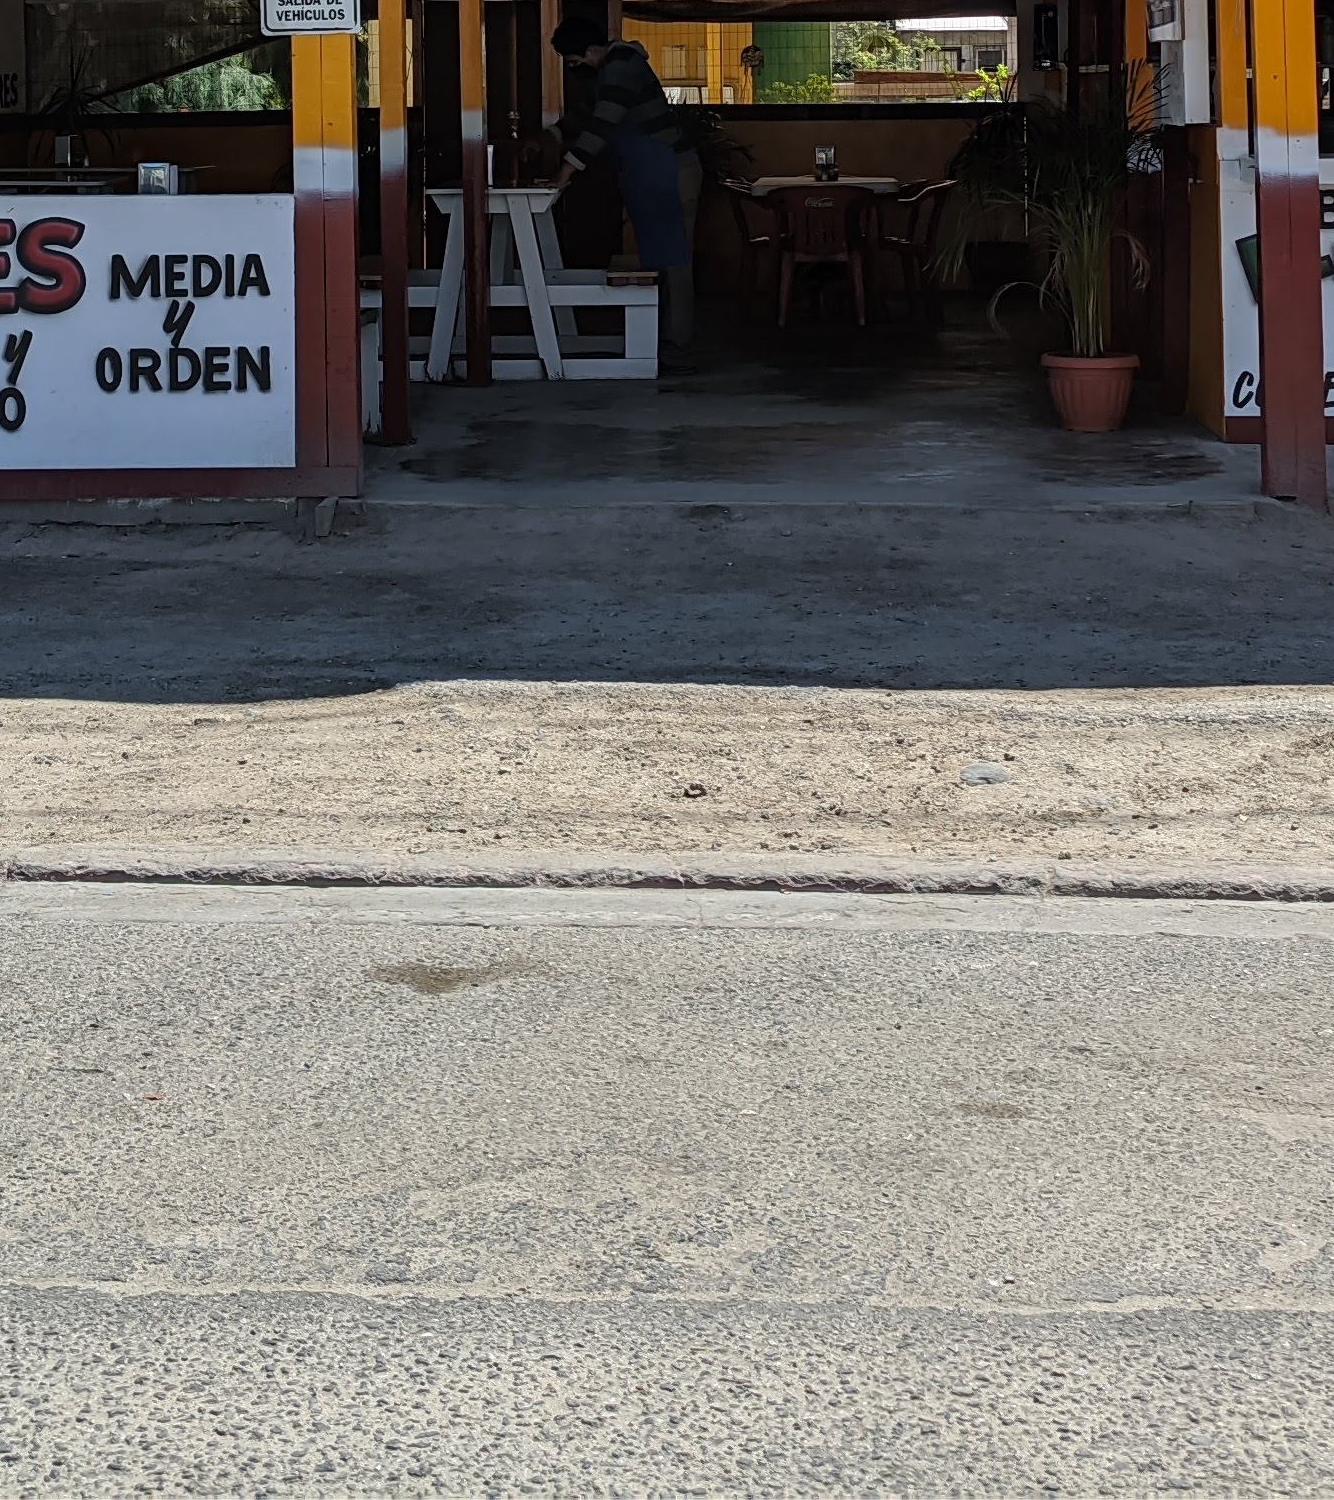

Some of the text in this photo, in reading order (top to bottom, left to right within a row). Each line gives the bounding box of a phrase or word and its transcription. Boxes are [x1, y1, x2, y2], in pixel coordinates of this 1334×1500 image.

[276, 6, 345, 21] VEHÍCULOS
[109, 253, 270, 299] MEDIA
[94, 344, 271, 393] ORDEN
